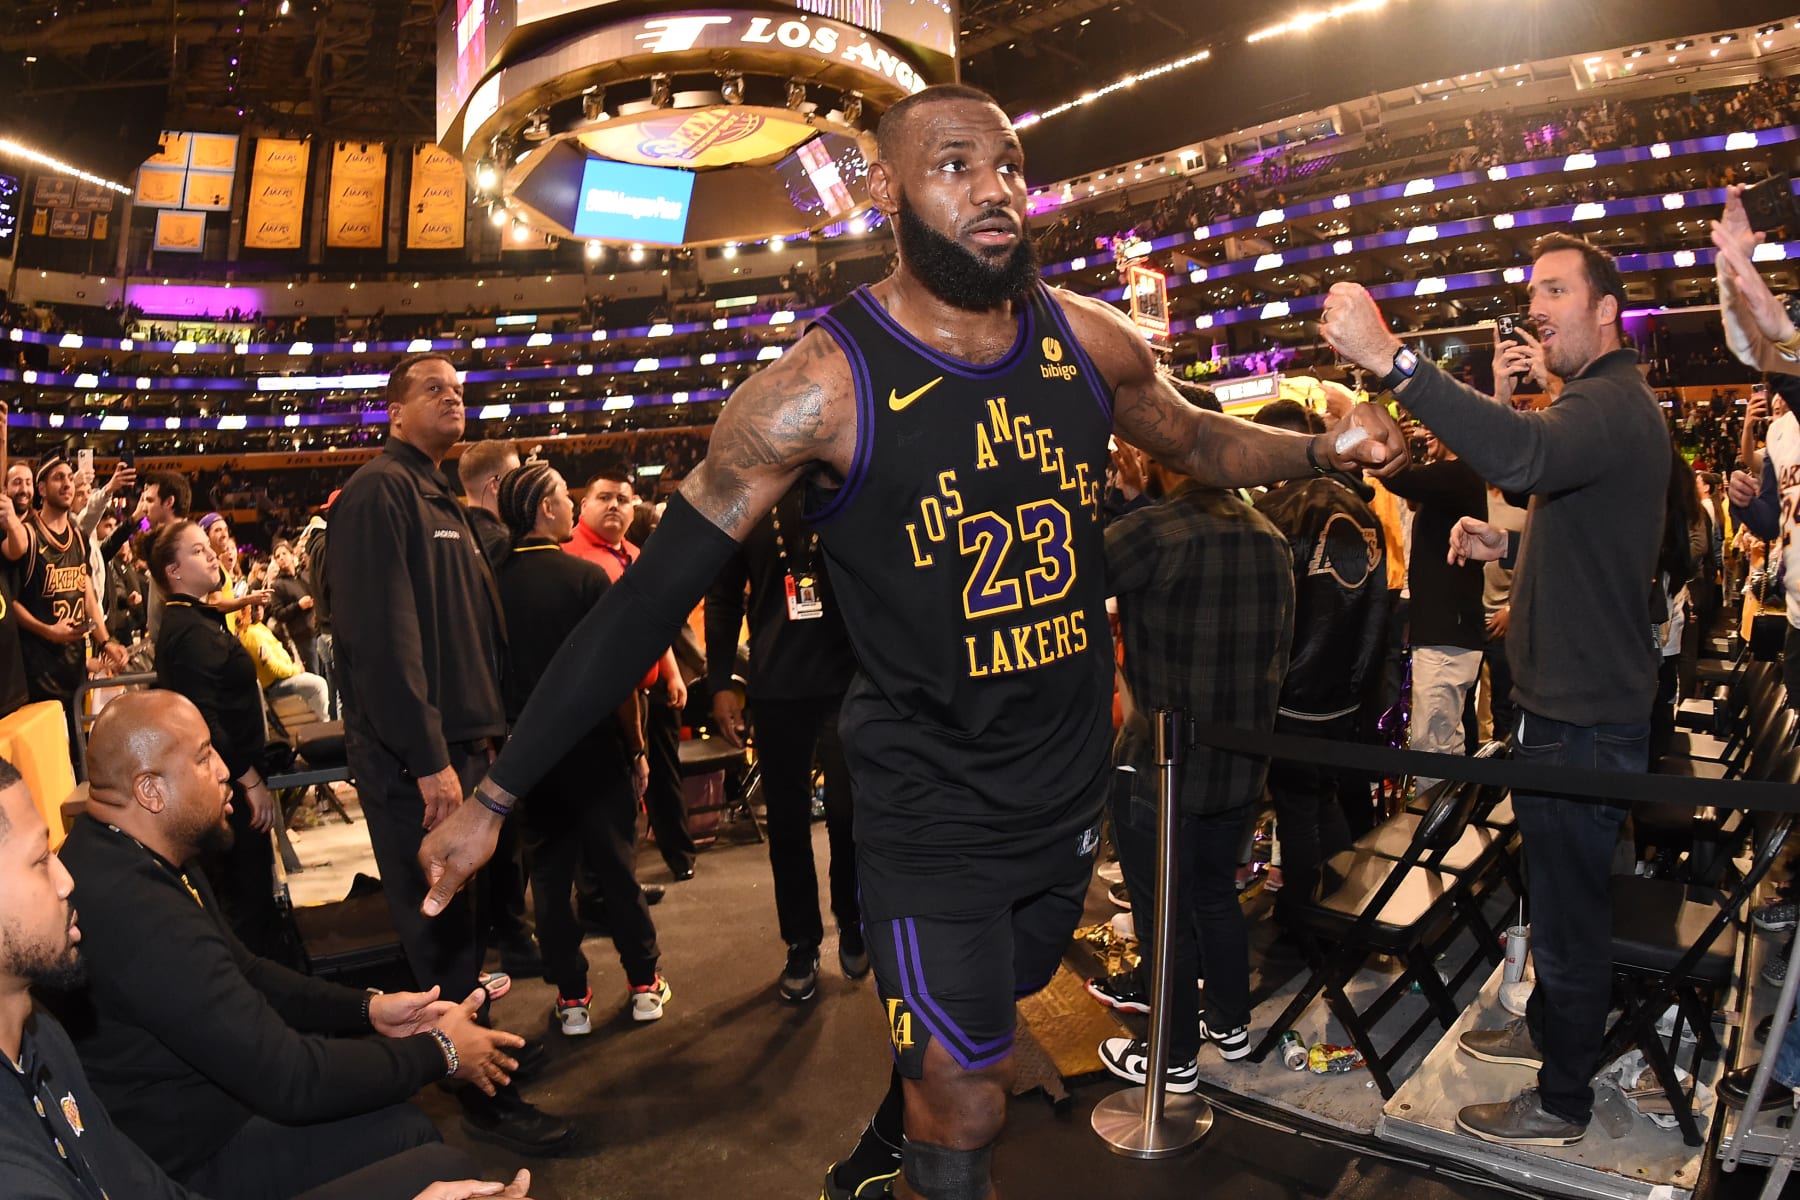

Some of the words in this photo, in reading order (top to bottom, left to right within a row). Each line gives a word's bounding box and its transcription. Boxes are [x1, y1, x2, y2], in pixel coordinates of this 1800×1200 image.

[740, 16, 840, 54] LOS
[1040, 363, 1077, 381] bibigo
[905, 470, 964, 568] LOS
[976, 397, 1100, 522] ANGELES
[957, 498, 1077, 620] 23
[966, 610, 1088, 678] LAKERS
